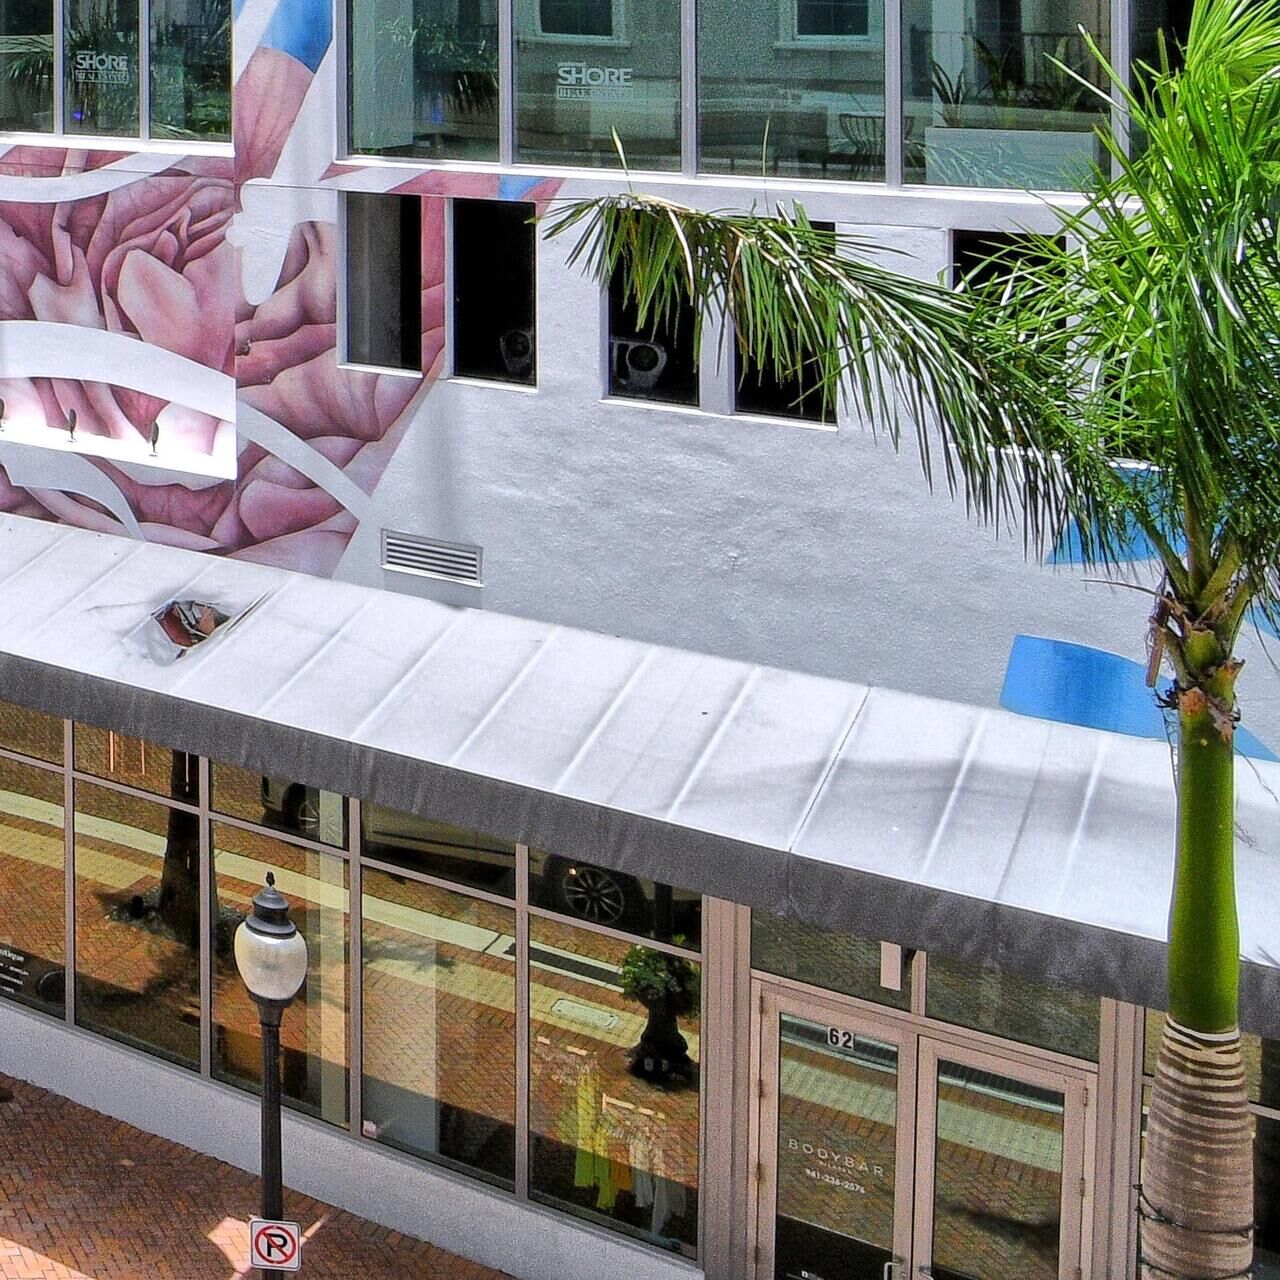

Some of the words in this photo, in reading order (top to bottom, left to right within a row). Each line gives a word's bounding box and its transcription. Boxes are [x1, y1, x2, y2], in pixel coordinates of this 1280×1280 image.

[76, 54, 129, 70] SHORE
[558, 67, 633, 87] SHORE
[829, 1027, 852, 1049] 62
[788, 1138, 884, 1177] BODYBAR
